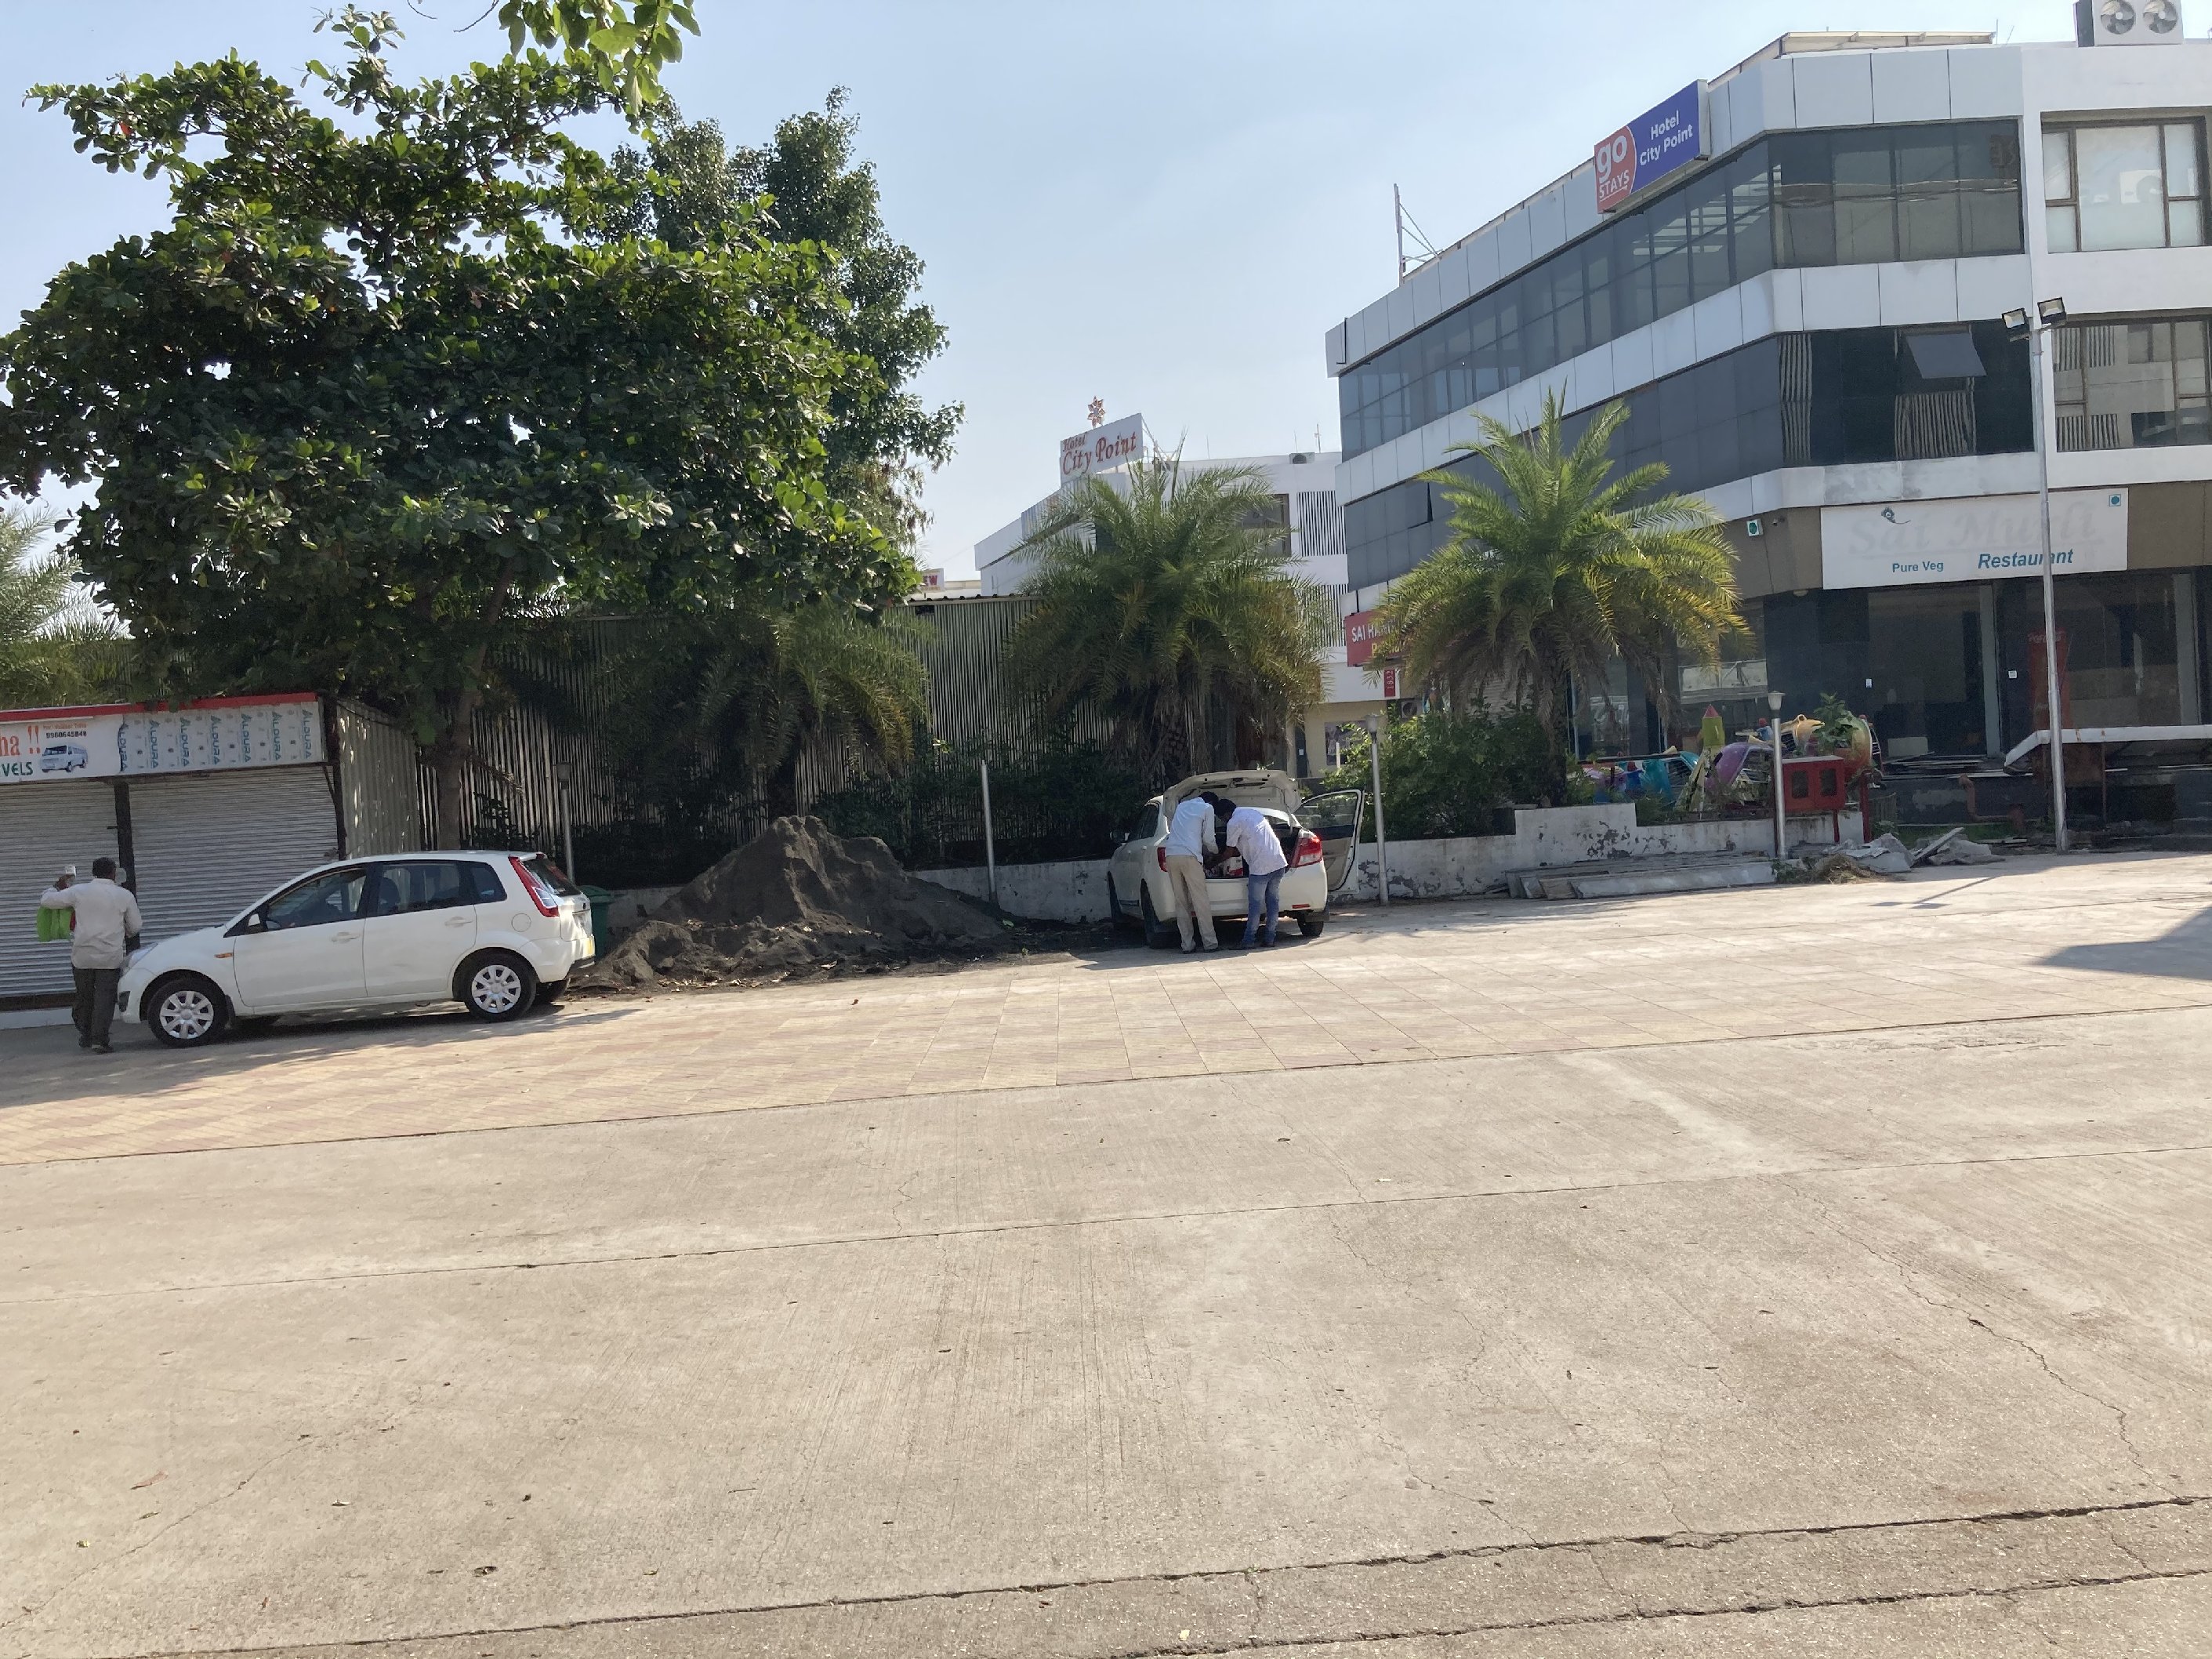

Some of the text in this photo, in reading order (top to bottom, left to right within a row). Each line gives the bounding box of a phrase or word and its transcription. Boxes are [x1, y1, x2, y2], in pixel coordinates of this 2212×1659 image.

[1640, 124, 1693, 166] City Point
[1651, 110, 1679, 140] Hotel
[1597, 135, 1628, 184] go
[1599, 169, 1630, 199] STAYS
[1063, 434, 1086, 452] Hotel
[1063, 431, 1137, 475] City Point
[1892, 561, 1944, 573] Pure Veg
[1351, 624, 1366, 643] SAI
[150, 720, 160, 768] ALDURA
[179, 717, 190, 766] ALDURA
[210, 714, 221, 764] ALDURA
[241, 713, 252, 762] ALDURA
[271, 711, 282, 760] ALDURA
[302, 709, 313, 758] ALDURA
